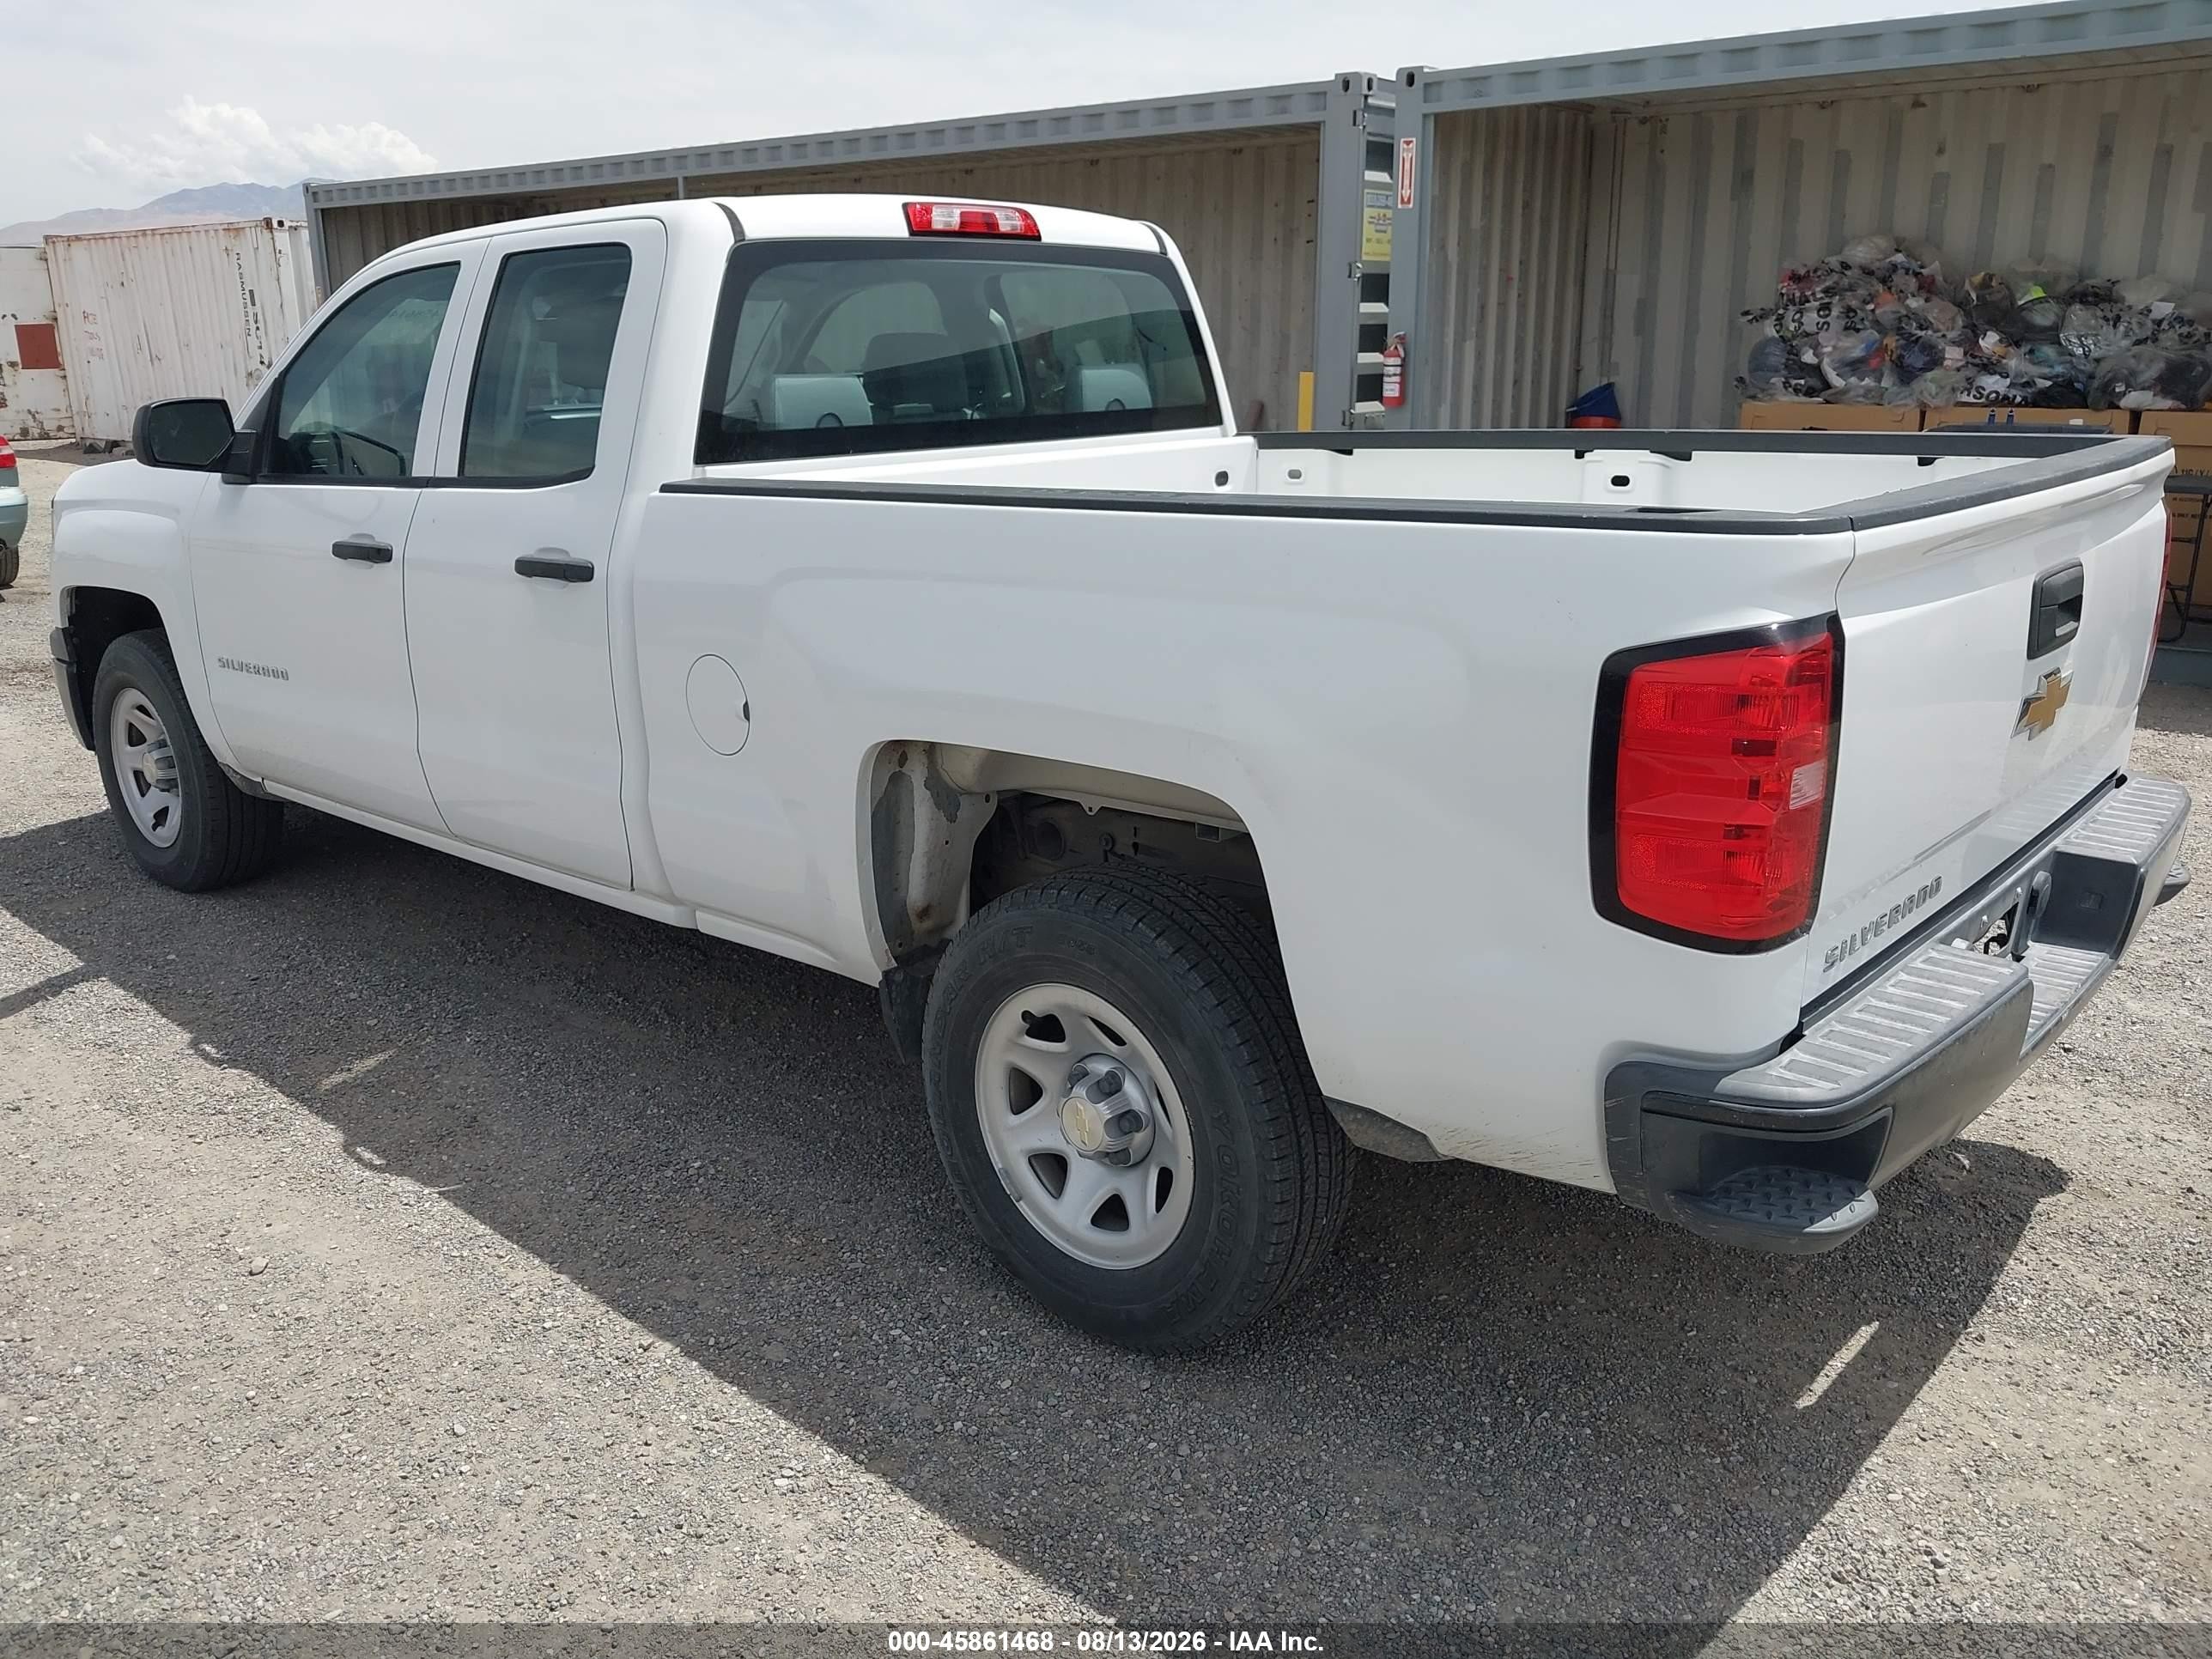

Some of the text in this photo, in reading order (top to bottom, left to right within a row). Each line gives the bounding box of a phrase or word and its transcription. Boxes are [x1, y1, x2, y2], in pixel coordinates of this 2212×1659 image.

[235, 252, 252, 337] RASMUSSEN
[218, 657, 289, 681] SILVERADO
[1823, 876, 1942, 973] SILVERADO
